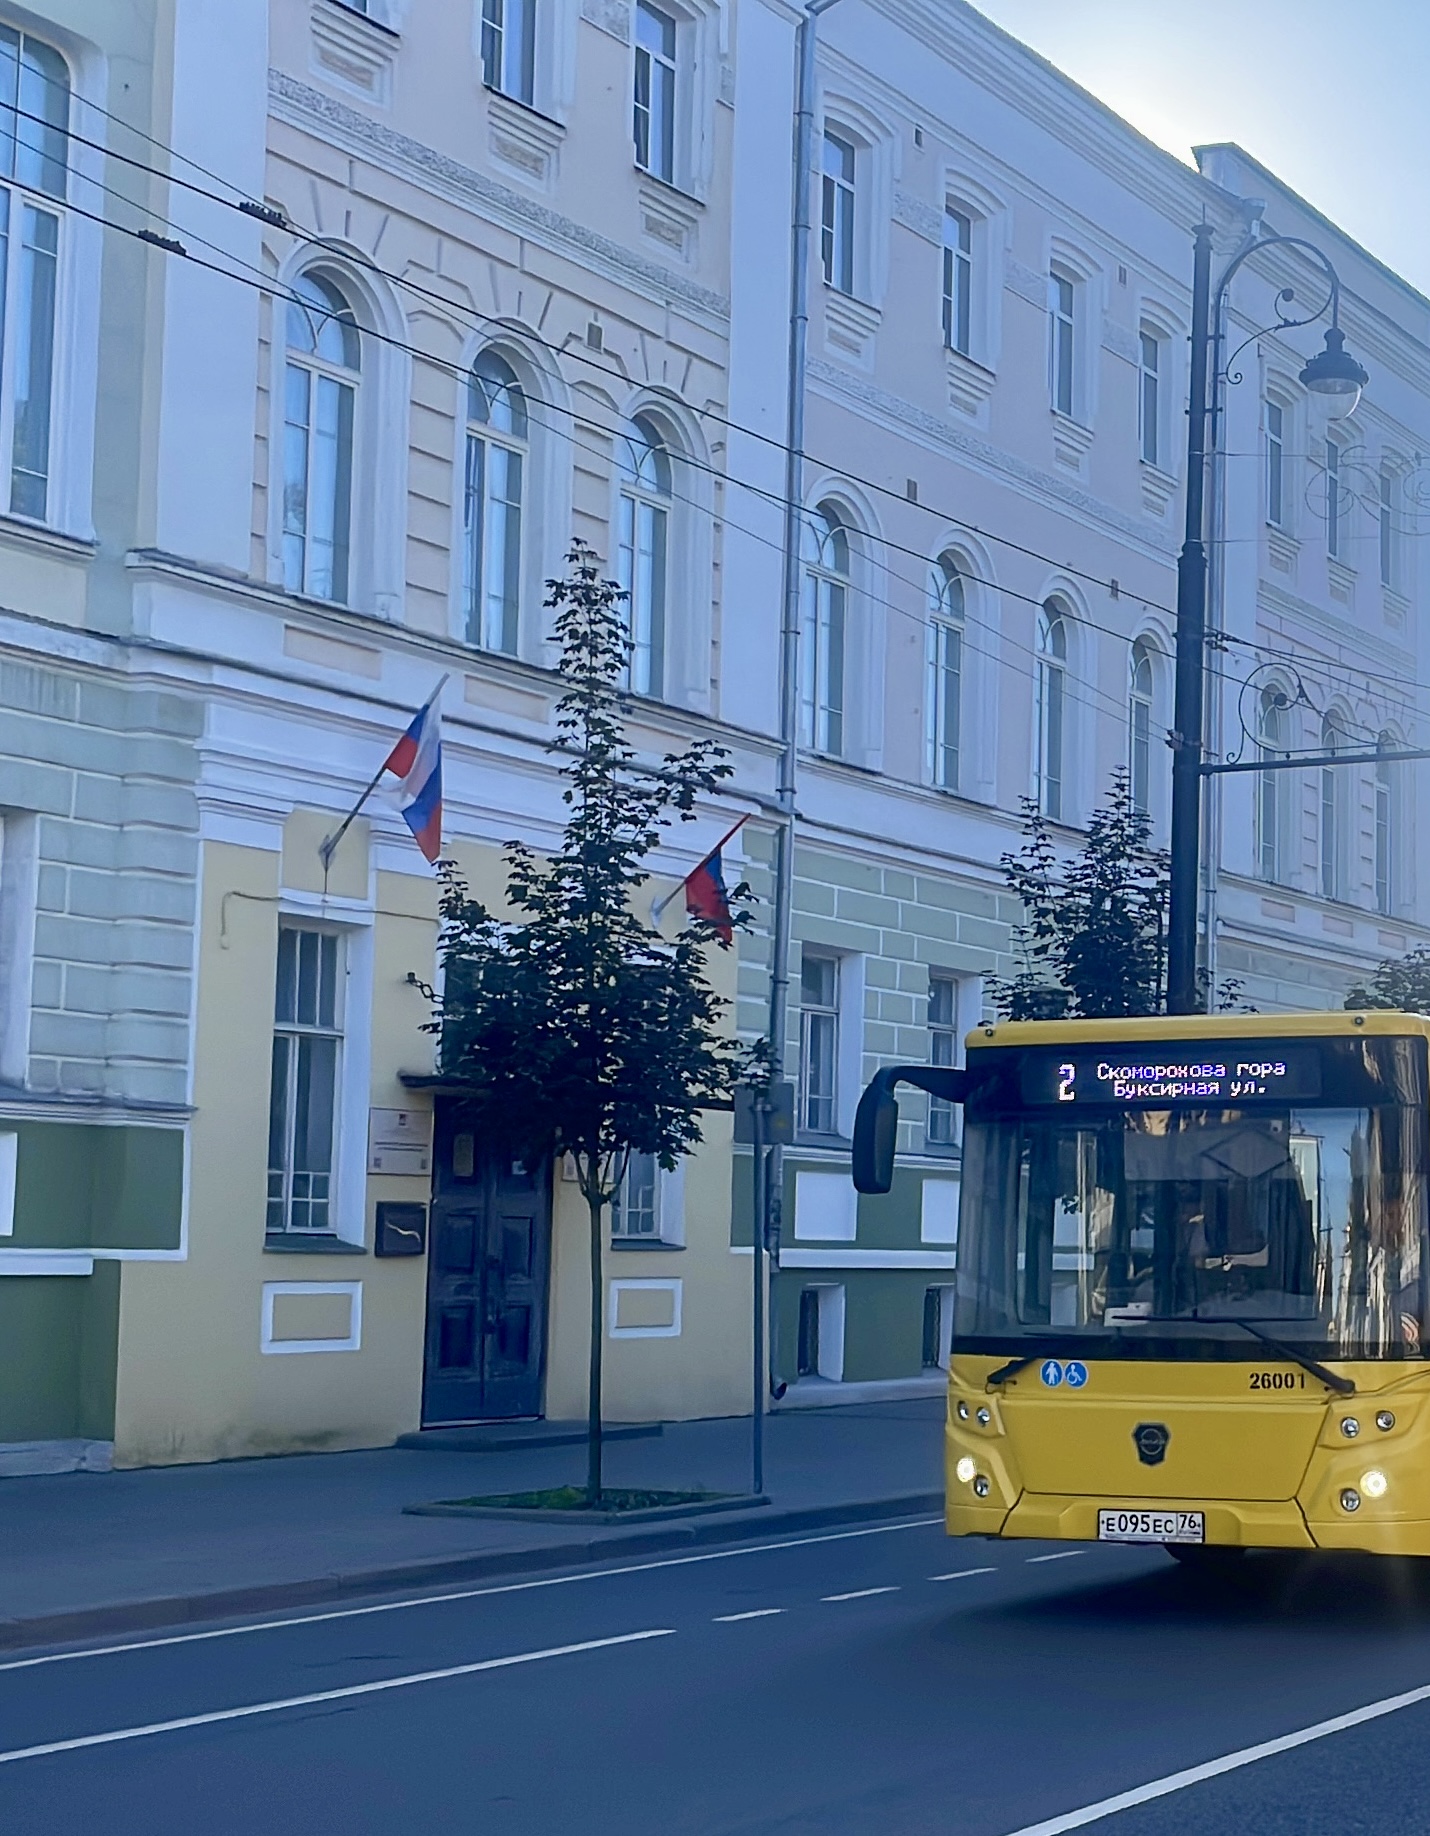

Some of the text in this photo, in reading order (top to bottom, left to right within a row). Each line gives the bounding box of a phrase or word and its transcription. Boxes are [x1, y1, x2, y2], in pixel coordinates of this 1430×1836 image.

[1097, 1062, 1286, 1081] Скоморохова гора
[1059, 1063, 1075, 1101] 2
[1114, 1079, 1266, 1099] Буксирная ул.
[1249, 1372, 1305, 1390] 26001
[1179, 1514, 1197, 1529] 76
